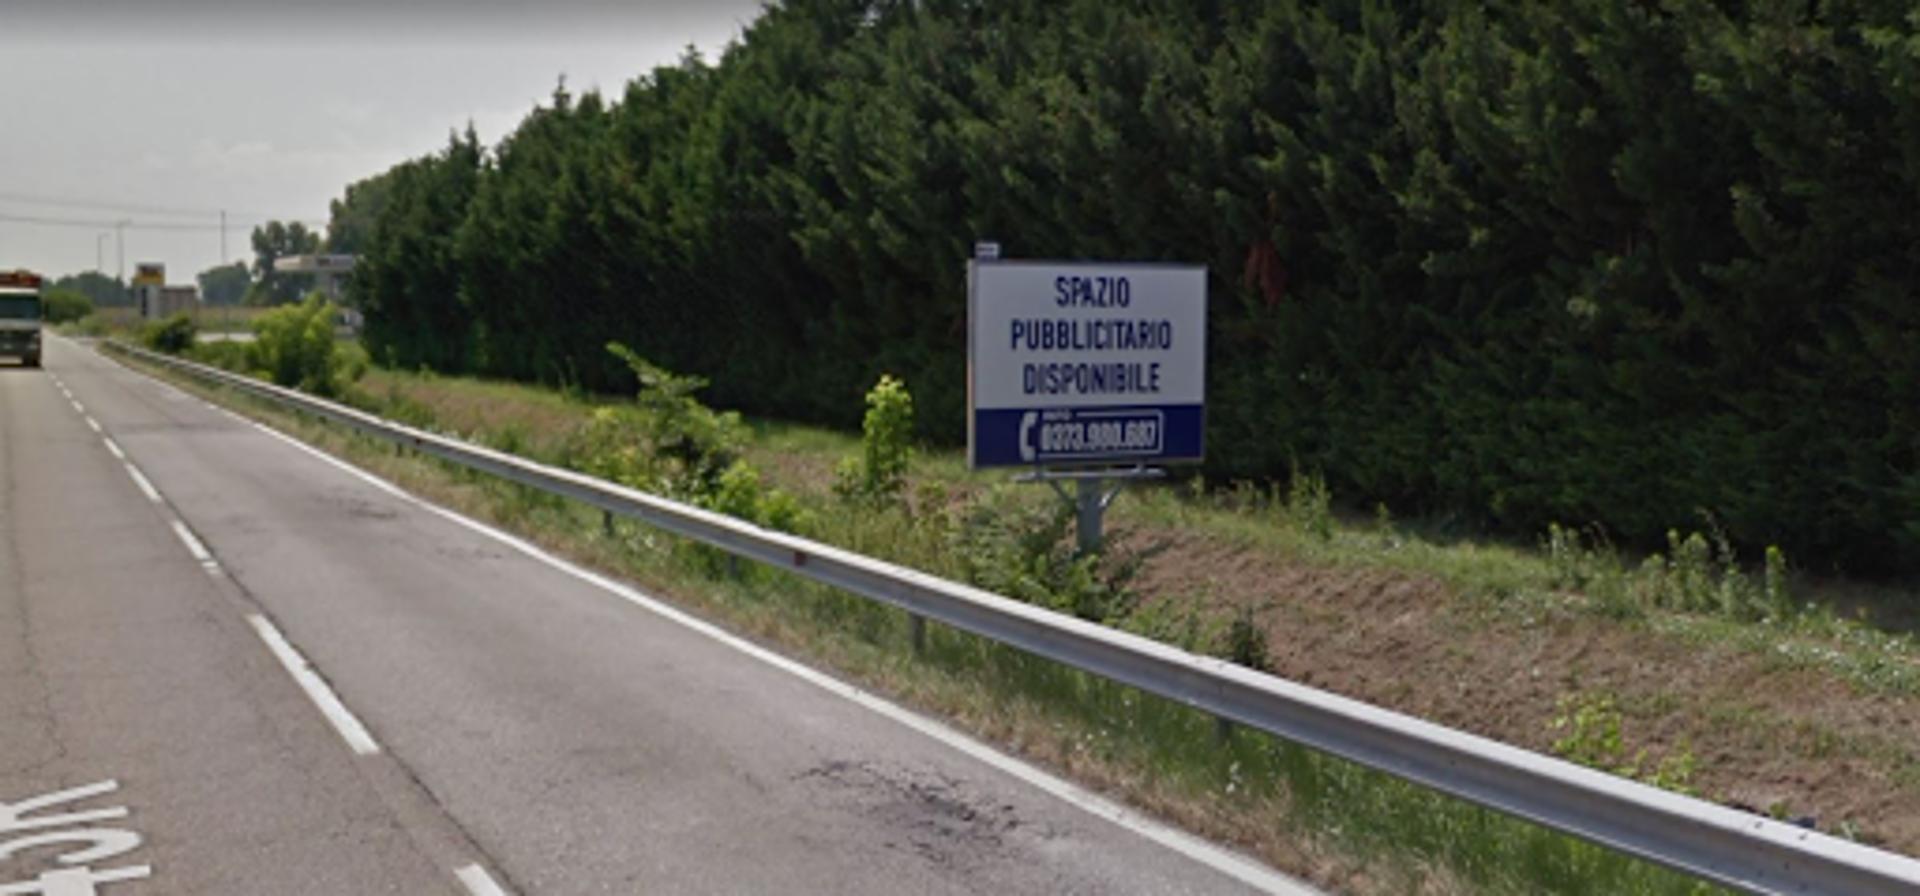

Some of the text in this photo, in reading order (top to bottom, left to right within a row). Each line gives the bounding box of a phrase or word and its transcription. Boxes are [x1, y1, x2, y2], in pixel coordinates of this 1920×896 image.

[1055, 276, 1131, 308] SPAZIO
[1011, 319, 1173, 350] PUBBLICITARIO
[1023, 363, 1161, 394] DISPONIBILE
